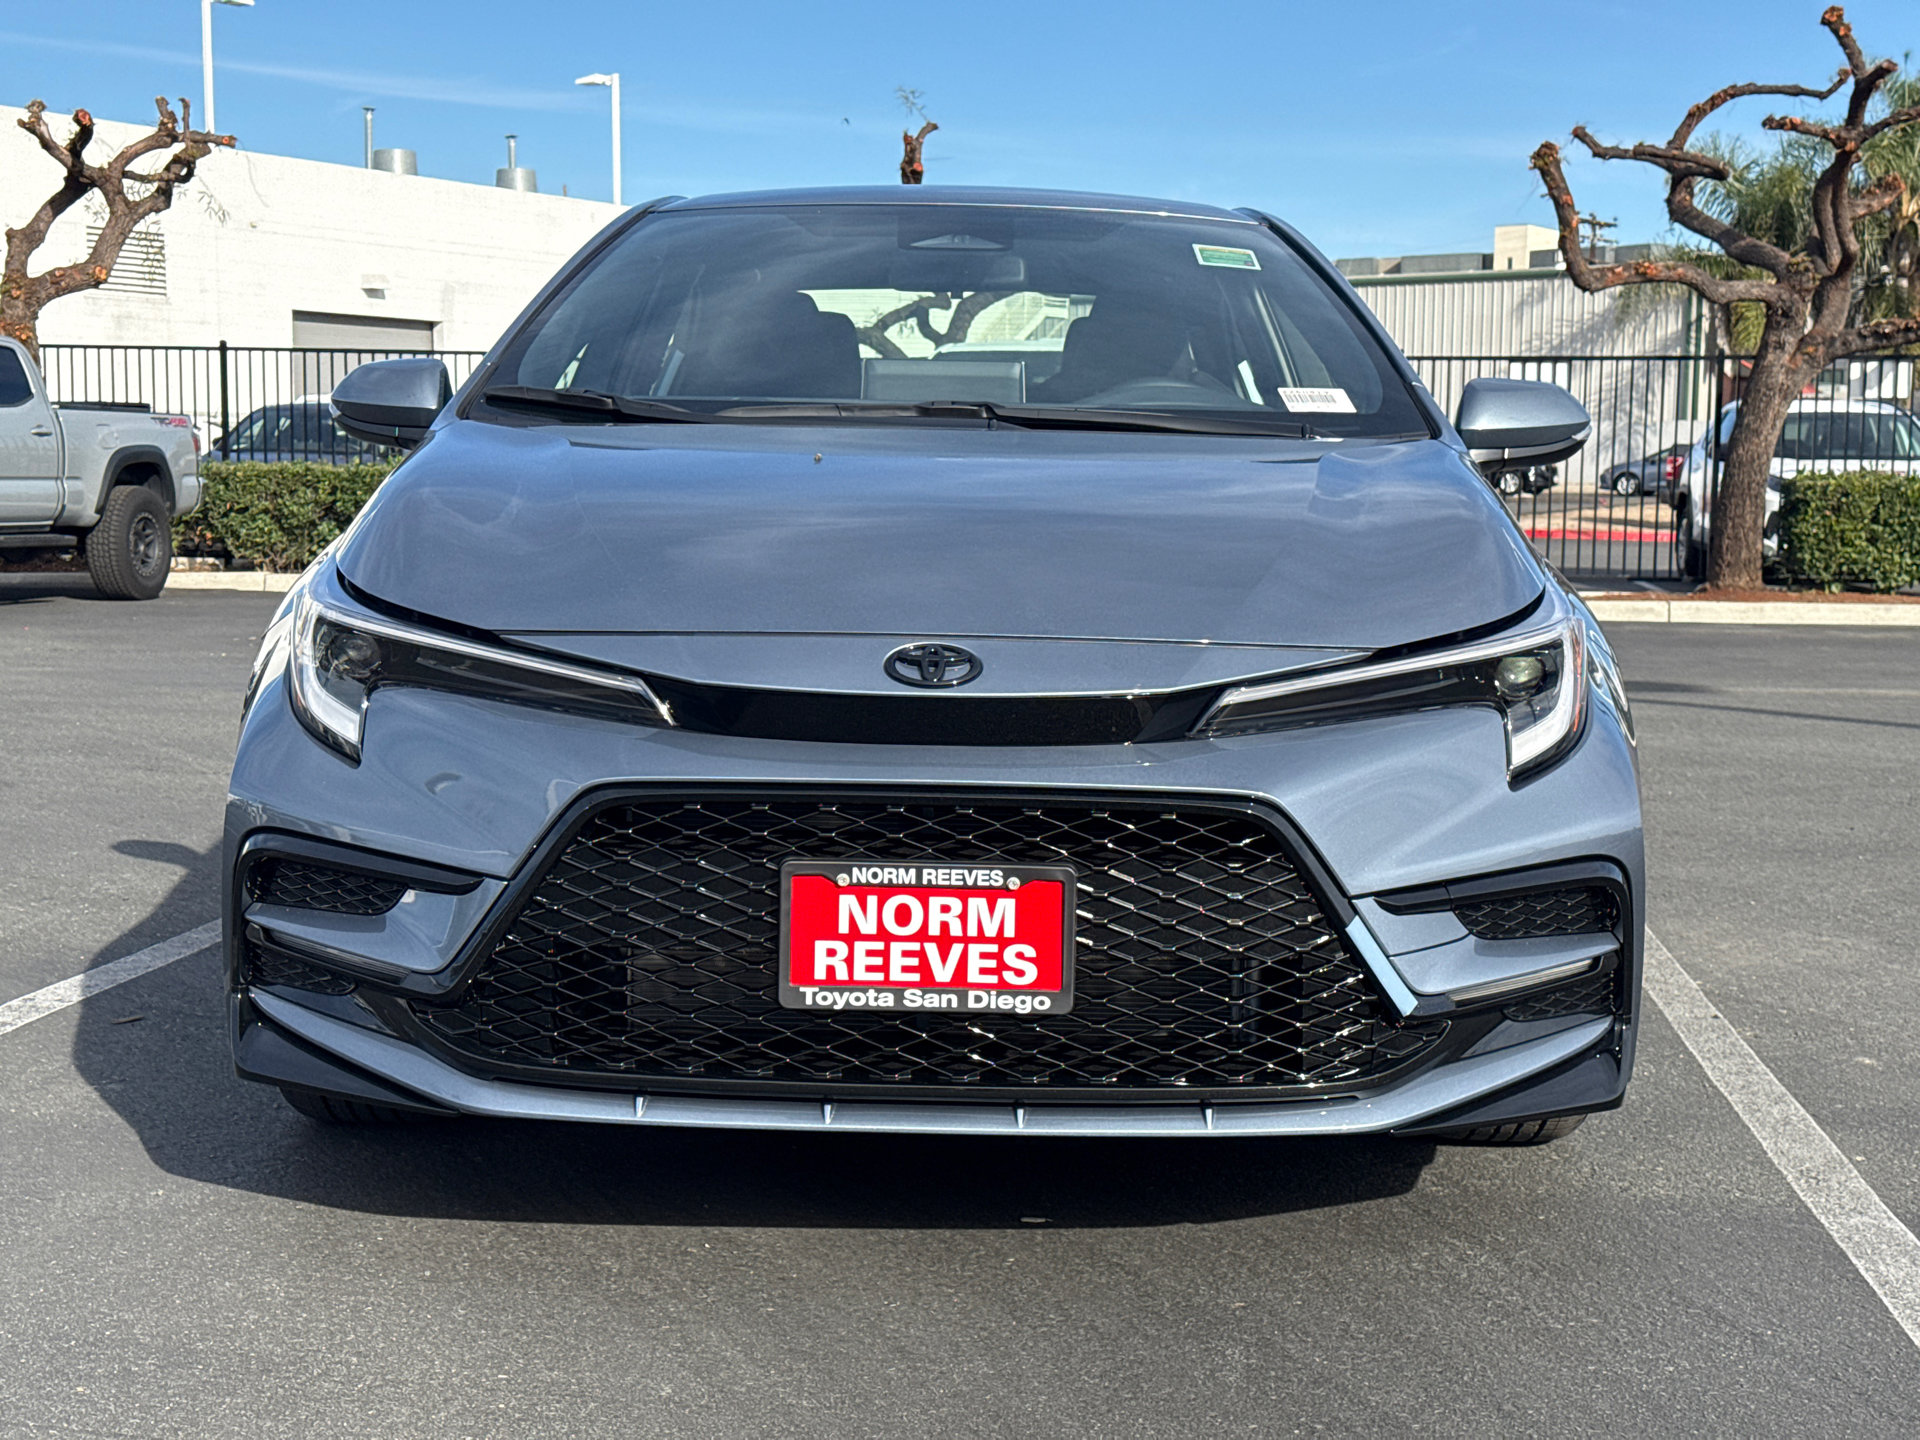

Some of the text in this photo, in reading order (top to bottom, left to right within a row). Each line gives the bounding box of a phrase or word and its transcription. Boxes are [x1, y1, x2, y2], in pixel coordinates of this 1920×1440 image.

[852, 867, 1004, 887] NORM REEVES
[838, 894, 1016, 938] NORM
[813, 940, 1038, 985] REEVES
[799, 987, 1051, 1014] Toyota San Diego
